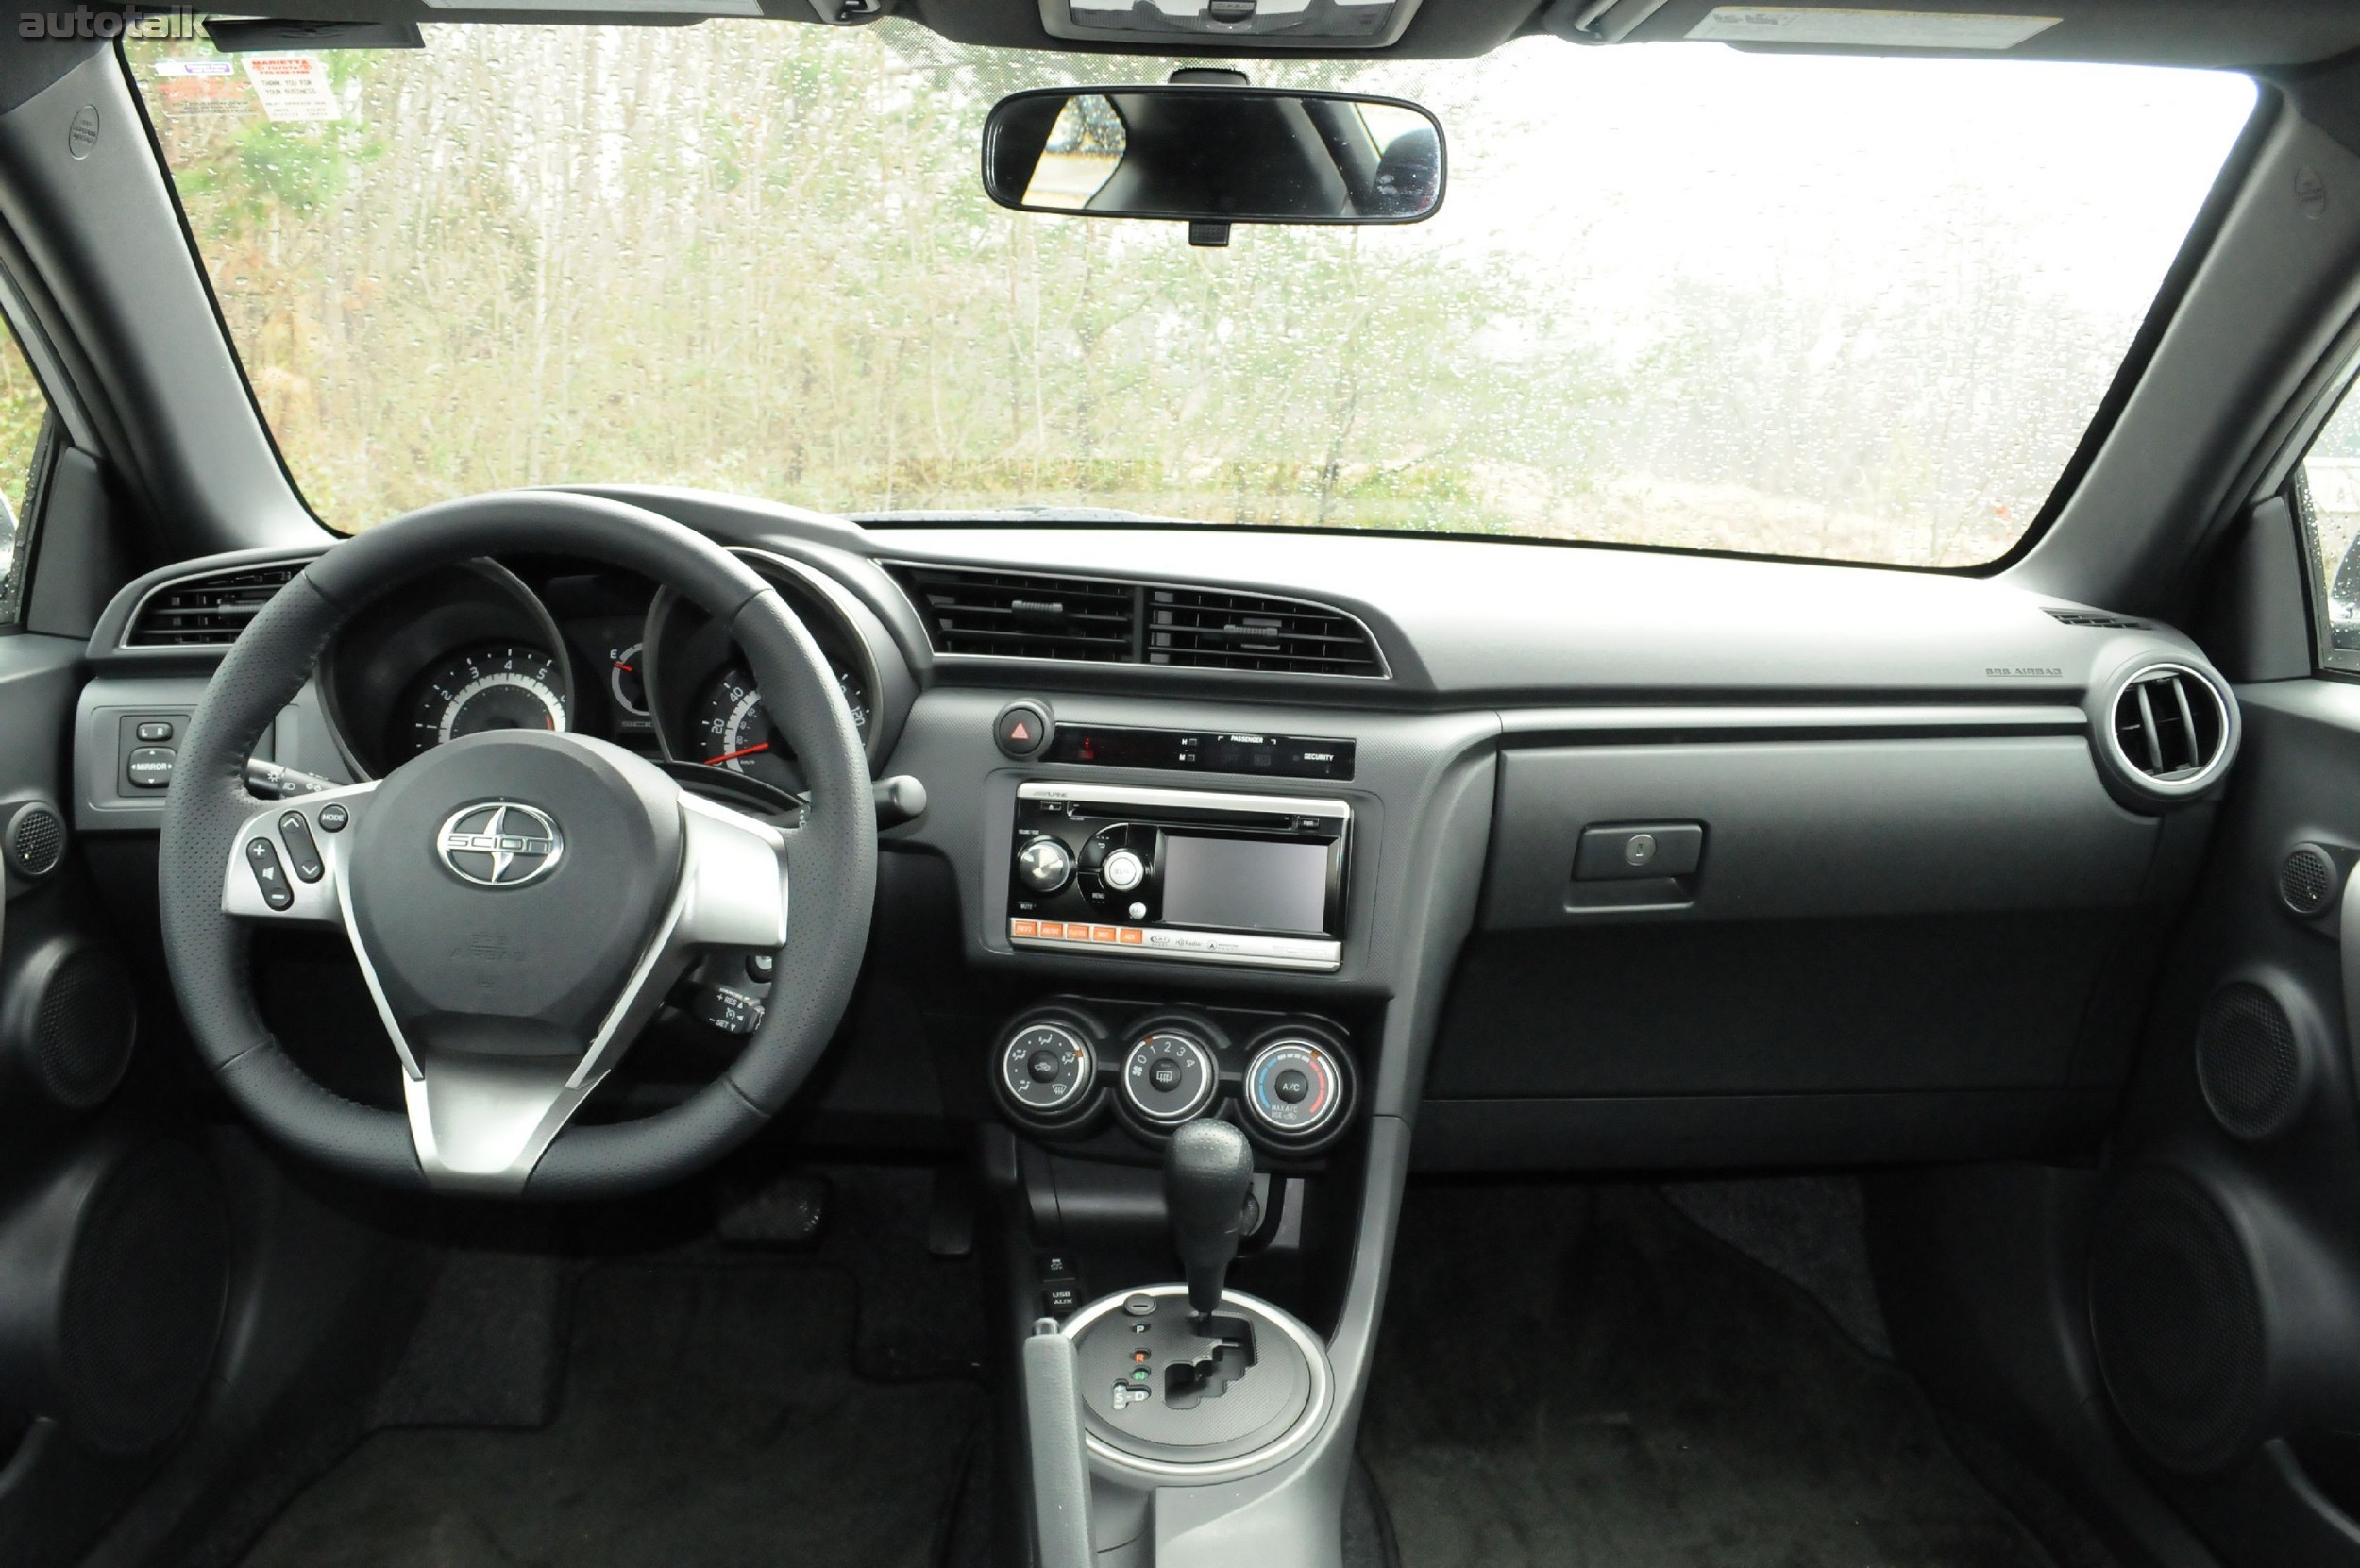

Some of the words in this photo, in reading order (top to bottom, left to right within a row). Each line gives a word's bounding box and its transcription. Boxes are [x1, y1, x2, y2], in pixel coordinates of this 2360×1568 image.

[610, 649, 618, 659] E
[503, 660, 513, 670] 4
[469, 666, 480, 679] 3
[536, 667, 548, 680] 5
[440, 689, 453, 700] 2
[729, 686, 744, 702] 40
[711, 718, 725, 734] 20
[141, 728, 148, 736] L
[157, 727, 164, 736] R
[1230, 735, 1264, 744] PASSENGER
[1304, 752, 1335, 762] SECURITY
[136, 762, 168, 771] MIRROR
[322, 813, 345, 822] MODE
[447, 835, 551, 854] SCION
[1149, 1045, 1156, 1054] 1
[1163, 1041, 1172, 1053] 2
[1176, 1046, 1186, 1056] 3
[1138, 1054, 1147, 1064] 0
[1186, 1059, 1195, 1068] 4
[1282, 1083, 1300, 1092] A/C
[1136, 1325, 1145, 1334] P
[1136, 1354, 1144, 1363] R
[1135, 1372, 1145, 1380] N
[1115, 1392, 1123, 1403] S
[1135, 1391, 1145, 1402] D
